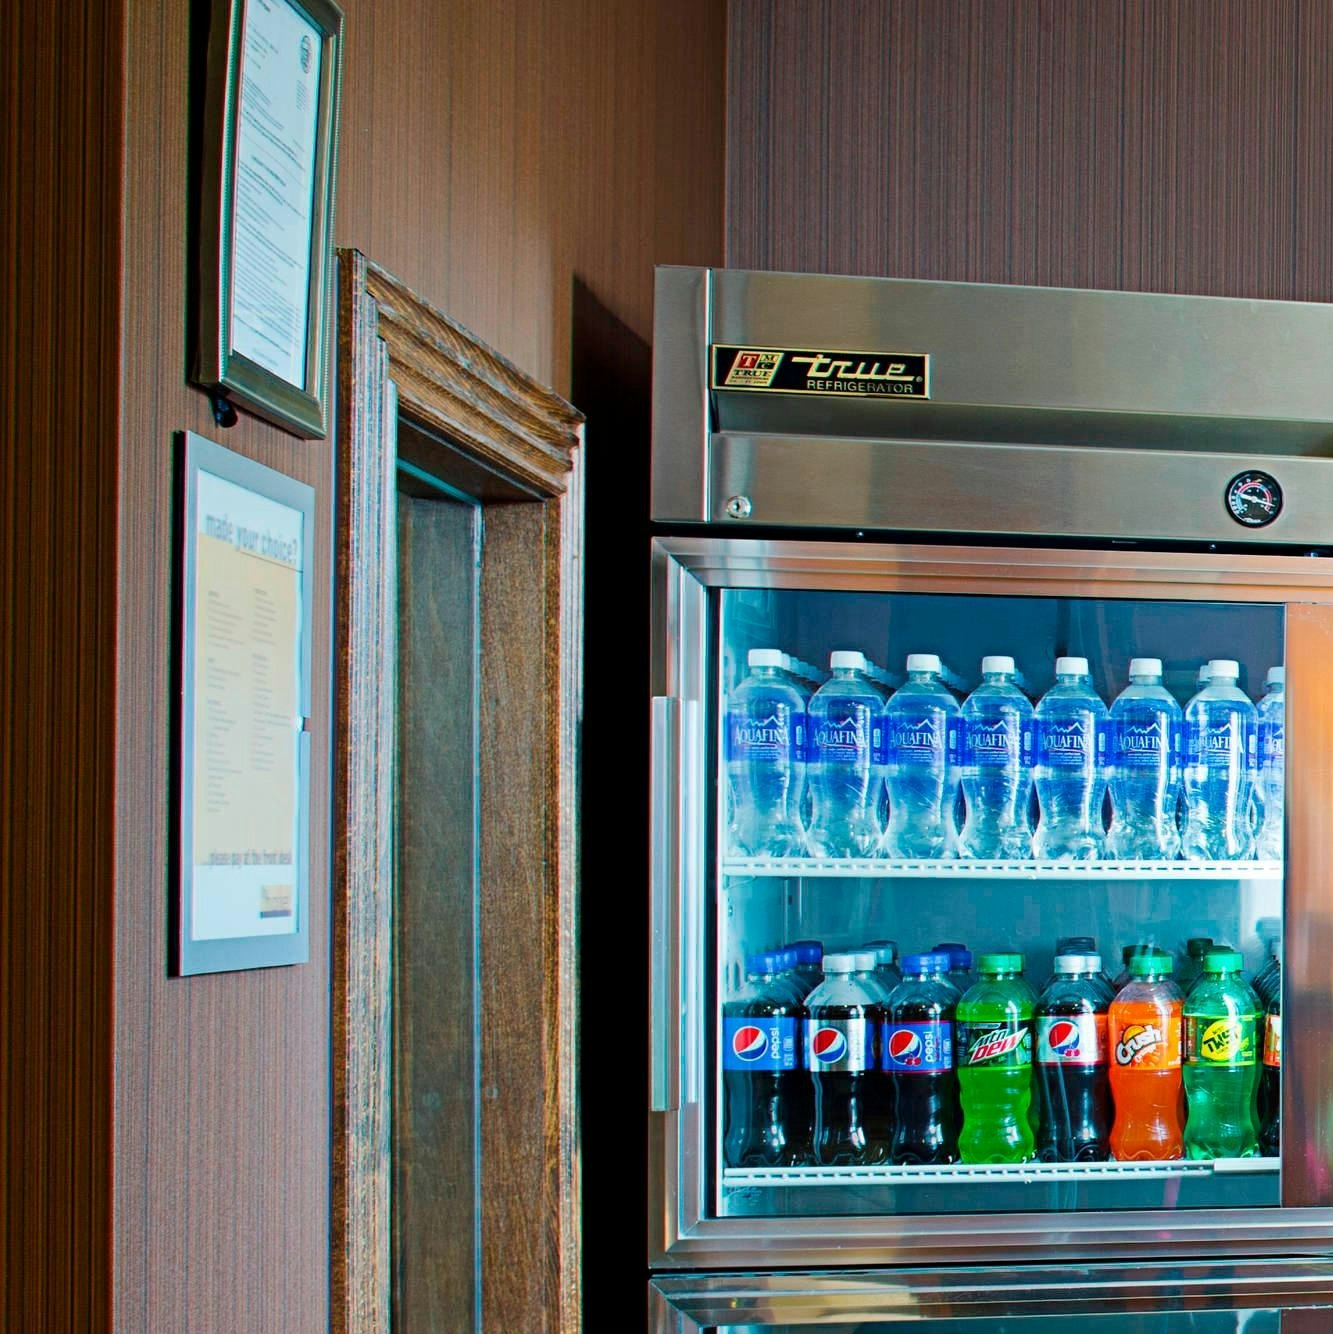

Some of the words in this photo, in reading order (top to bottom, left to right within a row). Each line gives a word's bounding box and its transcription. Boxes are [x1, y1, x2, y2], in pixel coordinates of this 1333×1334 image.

[807, 379, 914, 394] REFRIGERATOR
[734, 728, 790, 748] AQUAFINA
[771, 1027, 780, 1060] pepsi
[924, 1031, 935, 1063] pepsi
[1115, 1024, 1163, 1066] Crush
